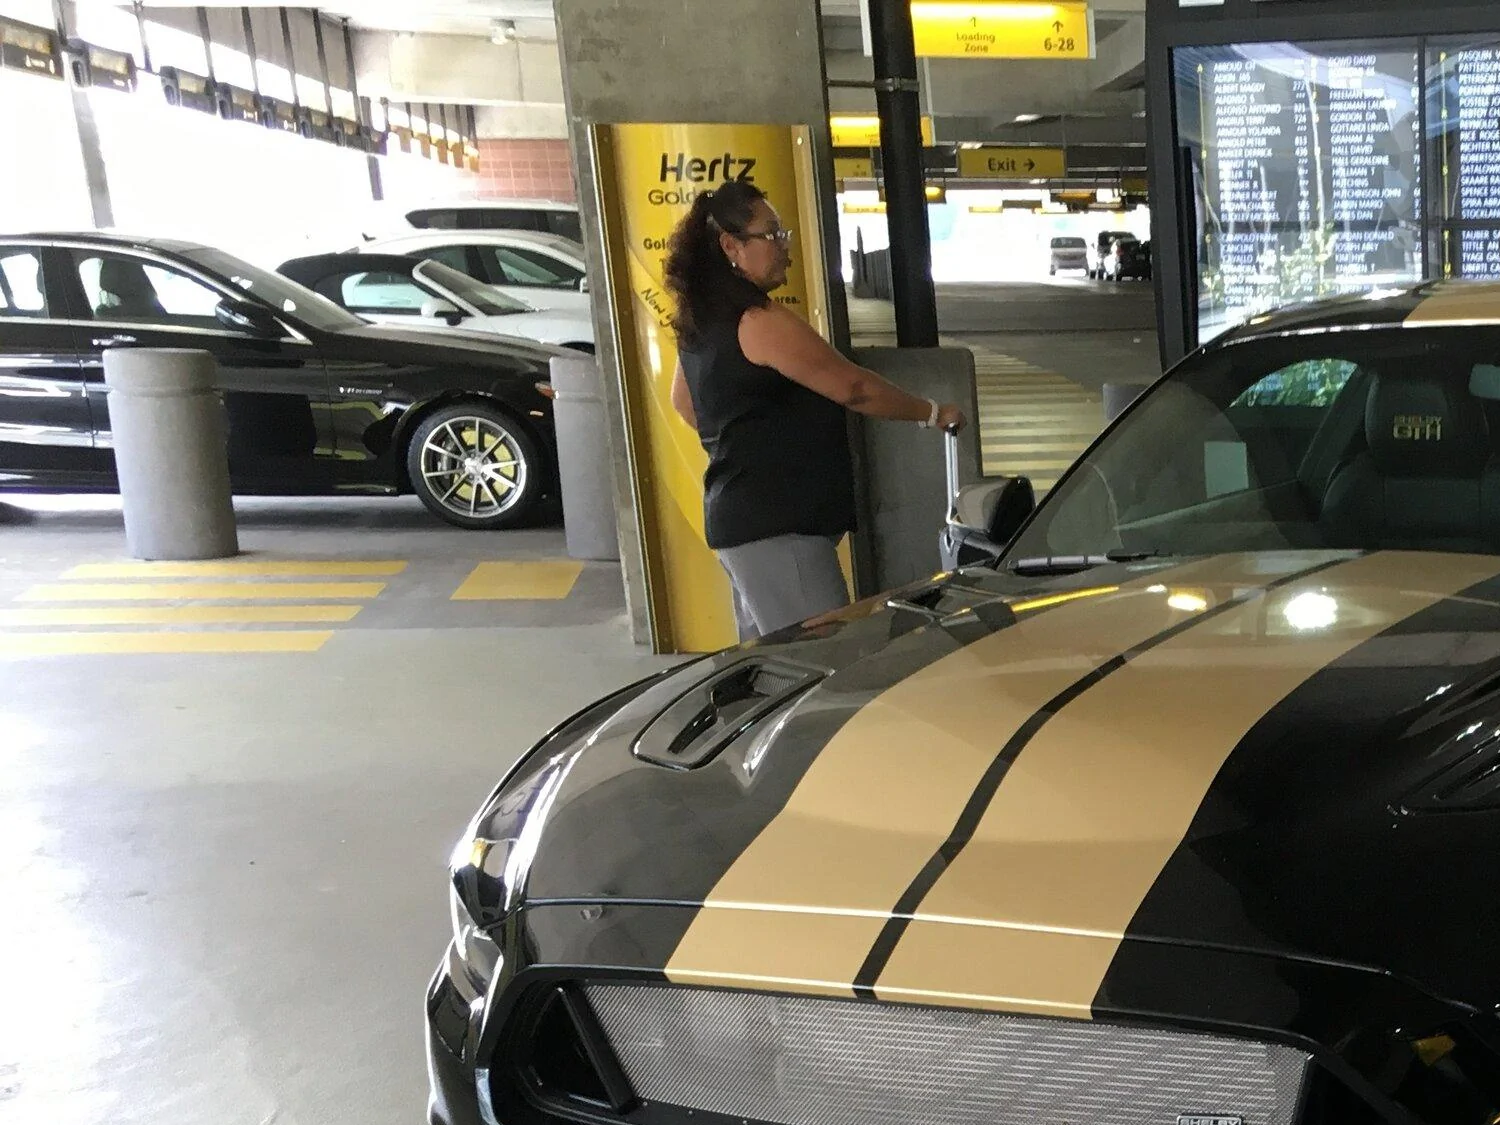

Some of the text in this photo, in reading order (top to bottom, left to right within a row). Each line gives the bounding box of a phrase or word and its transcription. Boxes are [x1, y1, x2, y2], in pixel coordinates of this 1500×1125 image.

[956, 33, 996, 44] Loading
[1044, 37, 1075, 51] 6-28
[964, 43, 989, 53] Zone
[659, 153, 757, 182] Hertz
[987, 158, 1016, 171] Exit
